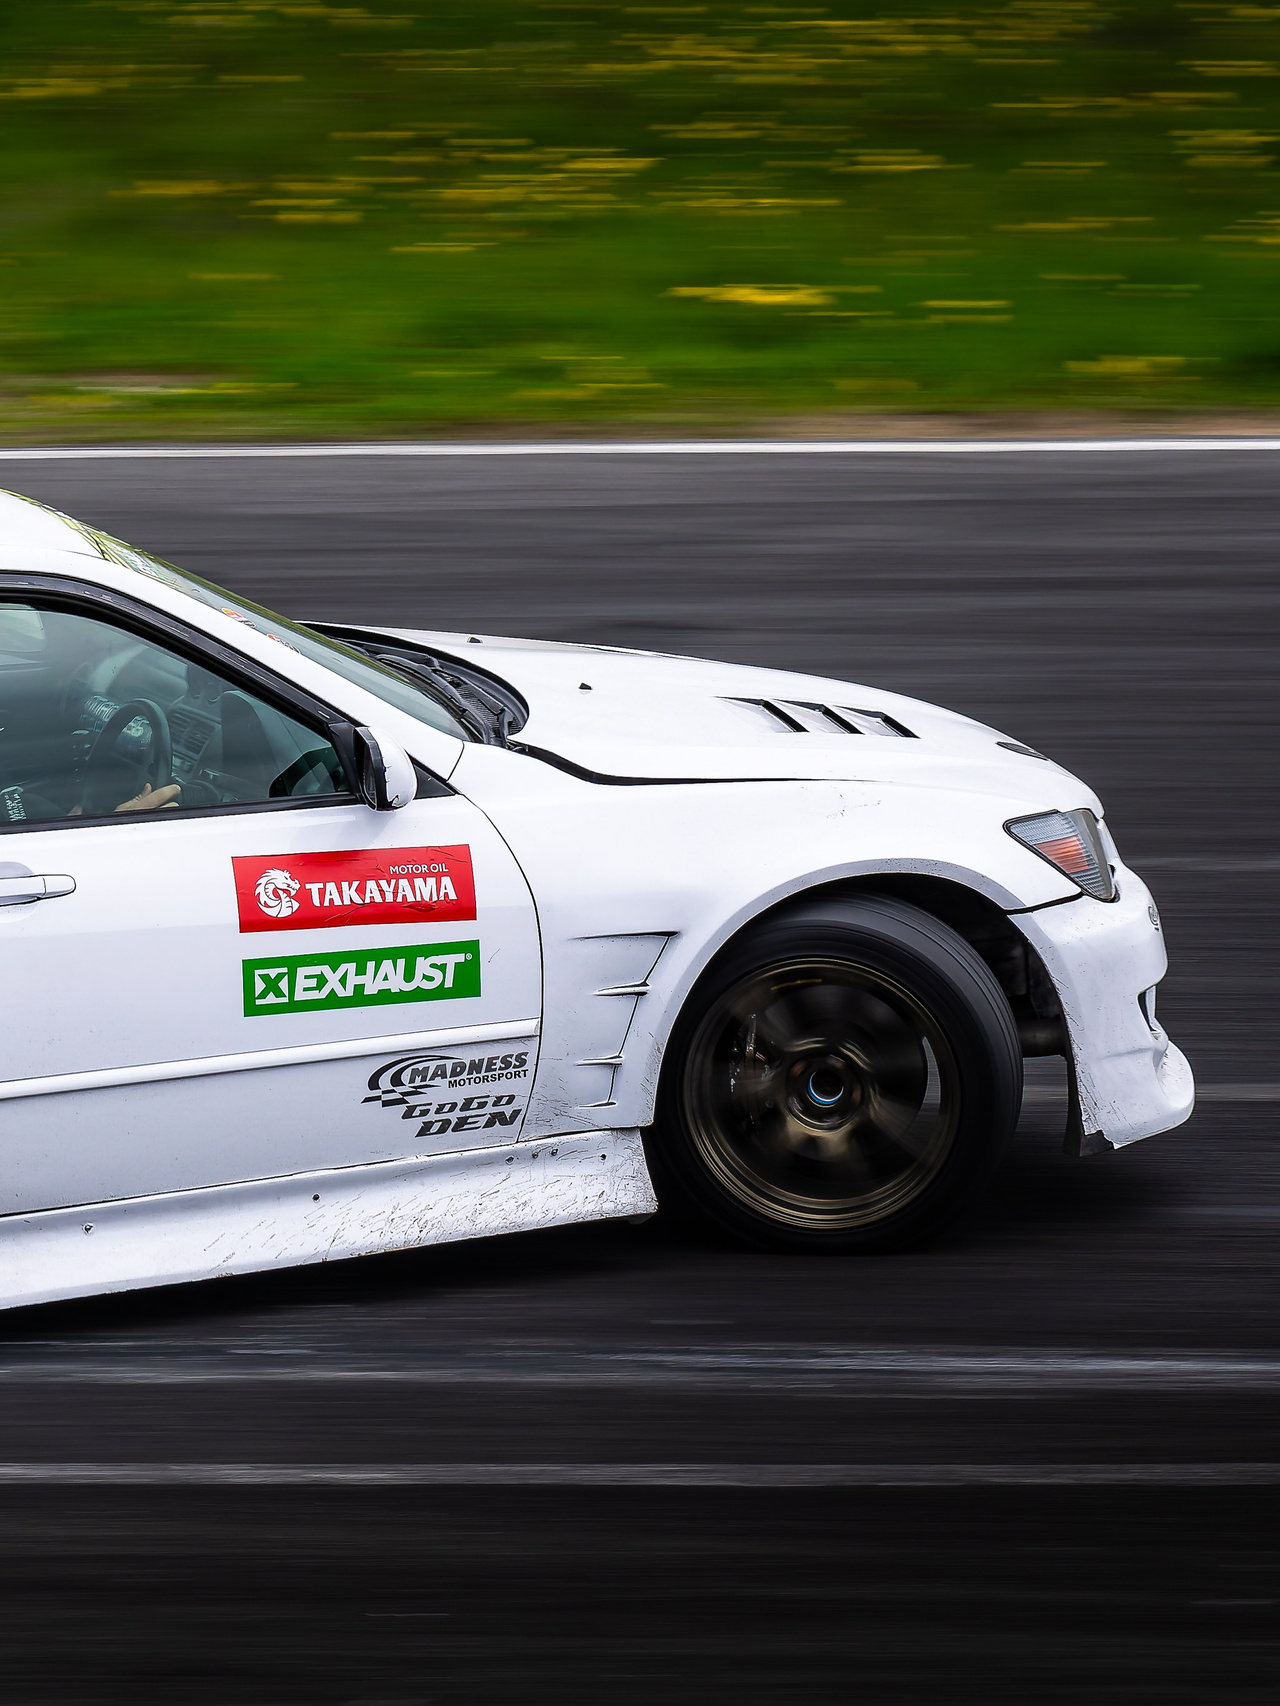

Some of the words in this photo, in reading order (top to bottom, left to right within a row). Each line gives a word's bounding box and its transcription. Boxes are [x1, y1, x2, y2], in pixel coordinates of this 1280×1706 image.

[389, 864, 428, 876] MOTOR
[430, 863, 449, 873] OIL
[305, 876, 458, 907] TAKAYAMA
[408, 1052, 529, 1084] MADNESS
[448, 1069, 529, 1089] MOTORSPORT
[415, 1108, 522, 1138] DEN
